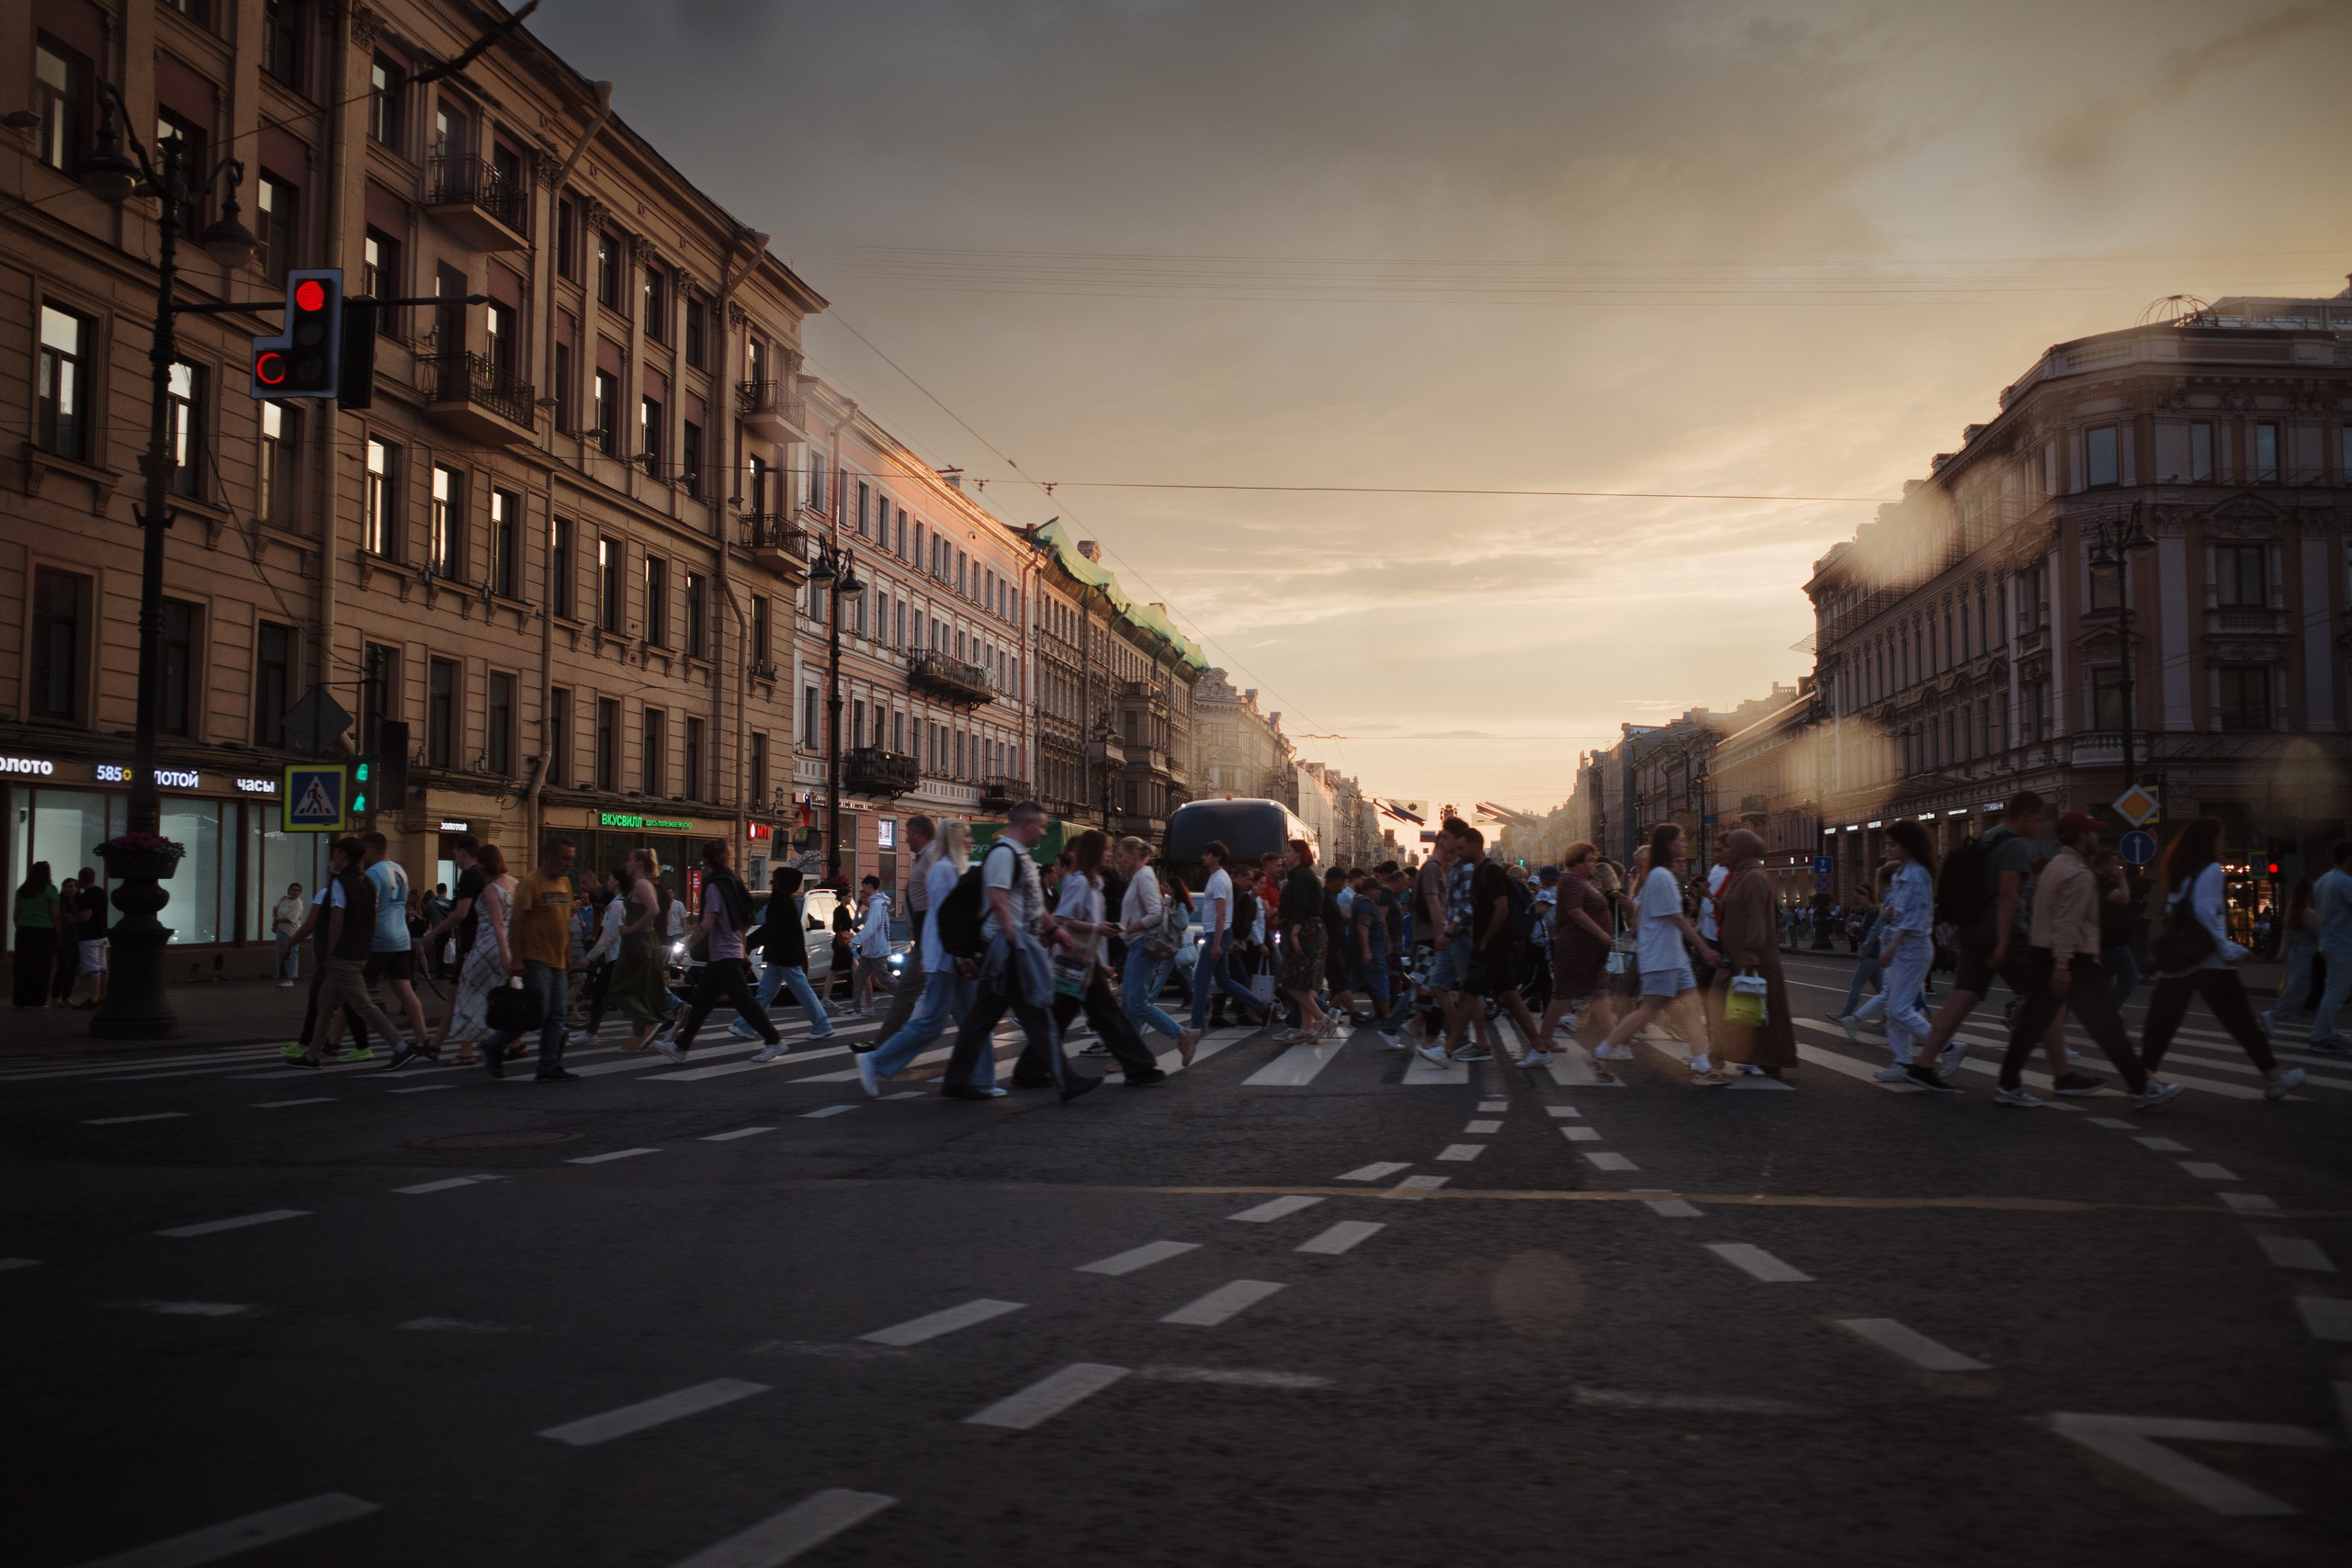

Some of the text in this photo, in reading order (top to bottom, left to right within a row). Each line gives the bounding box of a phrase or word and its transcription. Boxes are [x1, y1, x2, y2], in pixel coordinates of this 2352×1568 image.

[96, 764, 123, 782] 585
[236, 778, 276, 793] часы
[601, 813, 642, 828] ВКУСВИЛЛ
[756, 824, 772, 840] МТС
